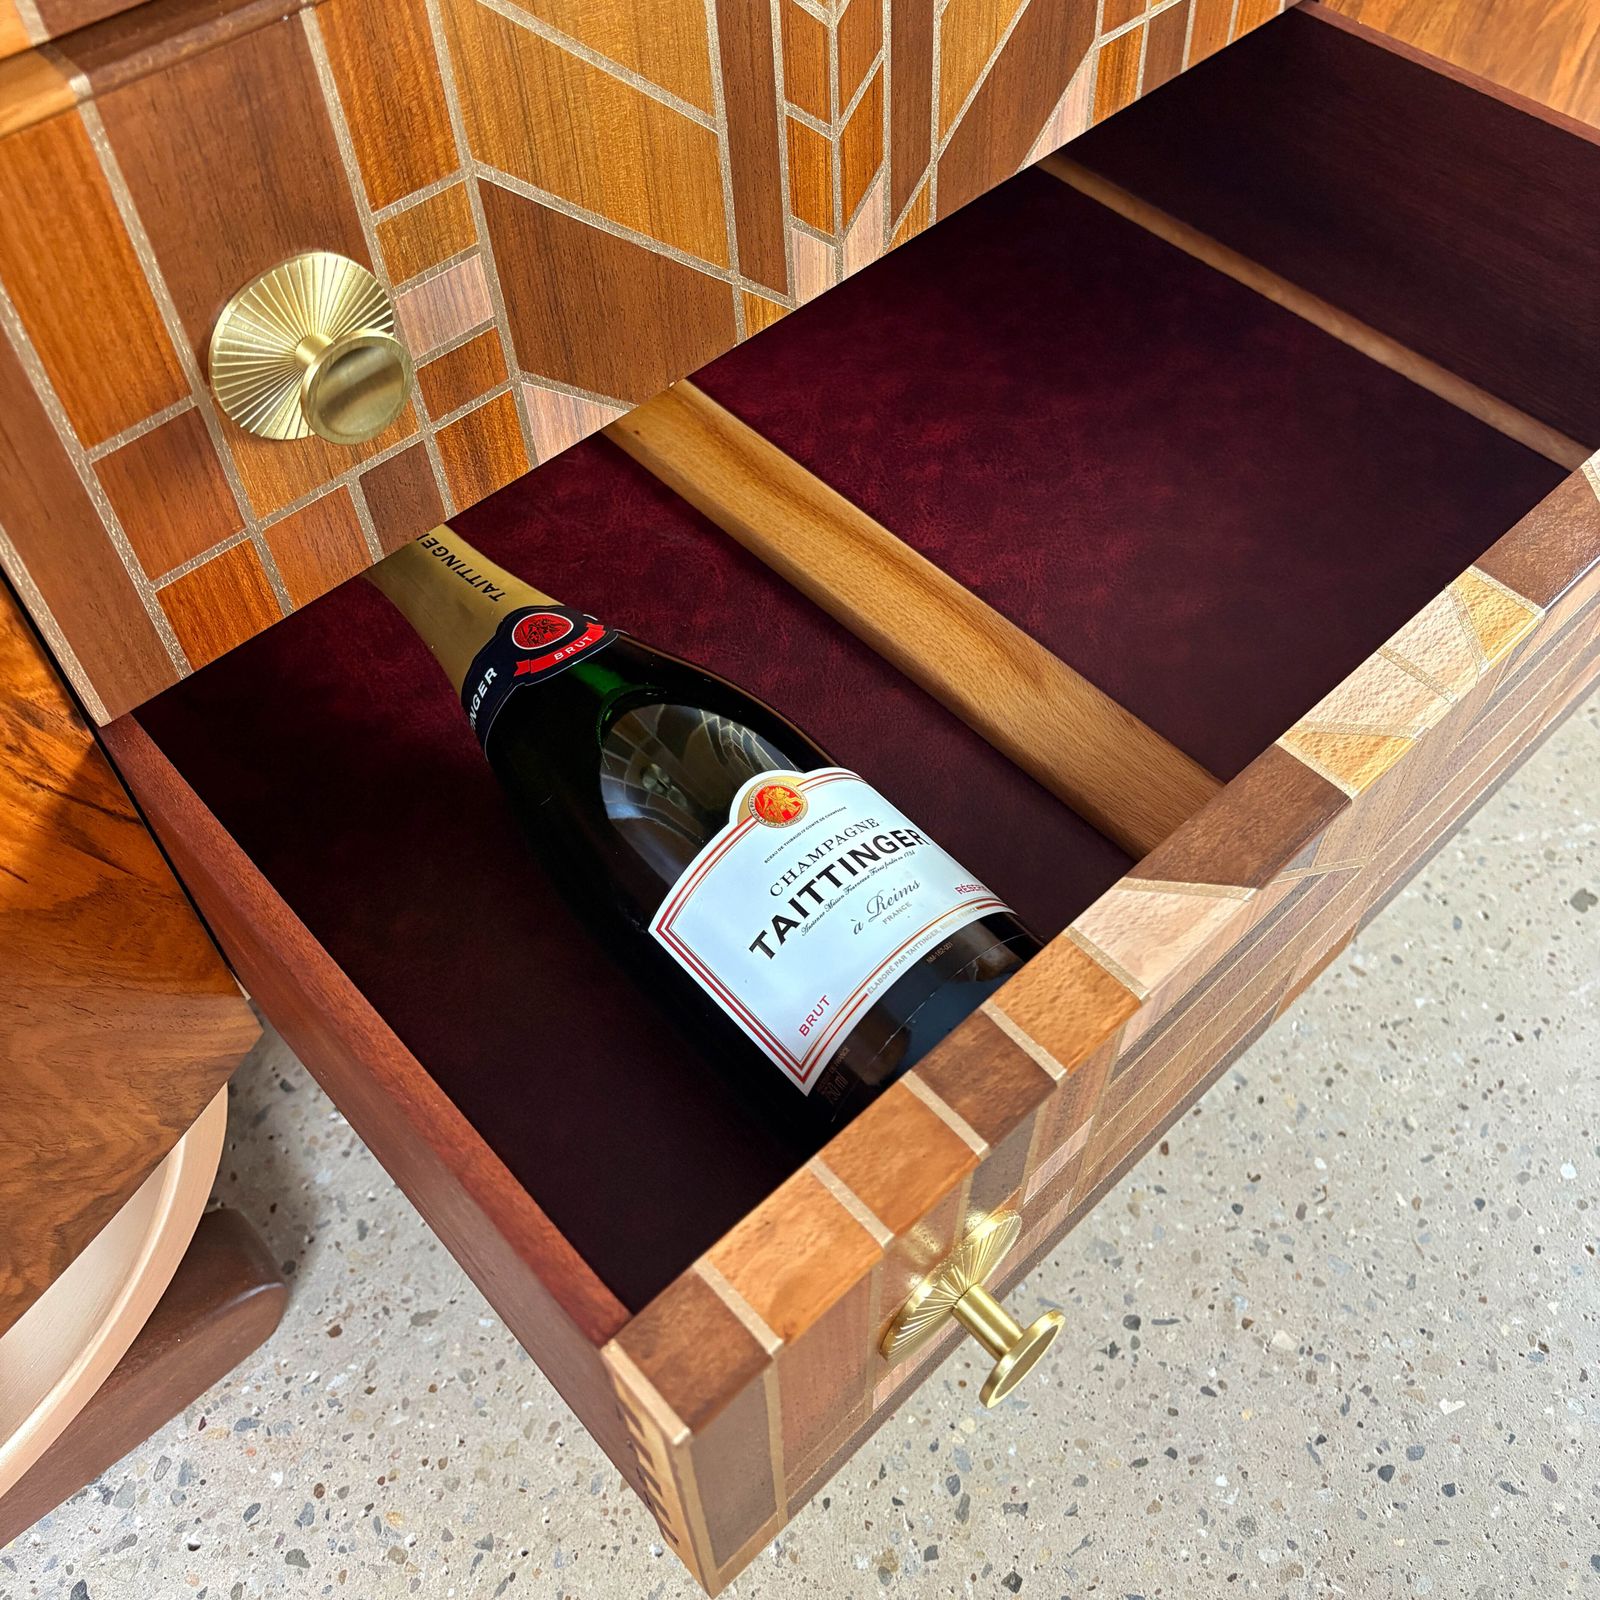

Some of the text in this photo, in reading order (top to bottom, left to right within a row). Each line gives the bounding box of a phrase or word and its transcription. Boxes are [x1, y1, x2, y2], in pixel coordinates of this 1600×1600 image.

[554, 635, 593, 661] BRUT
[769, 817, 880, 897] CHAMPAGNE
[748, 828, 931, 960] TAITTINGER
[850, 880, 920, 936] à Reims
[882, 901, 913, 925] FRANCE
[867, 964, 896, 995] ÉLABORÉ
[894, 954, 908, 968] PAR
[798, 994, 831, 1037] BRUT
